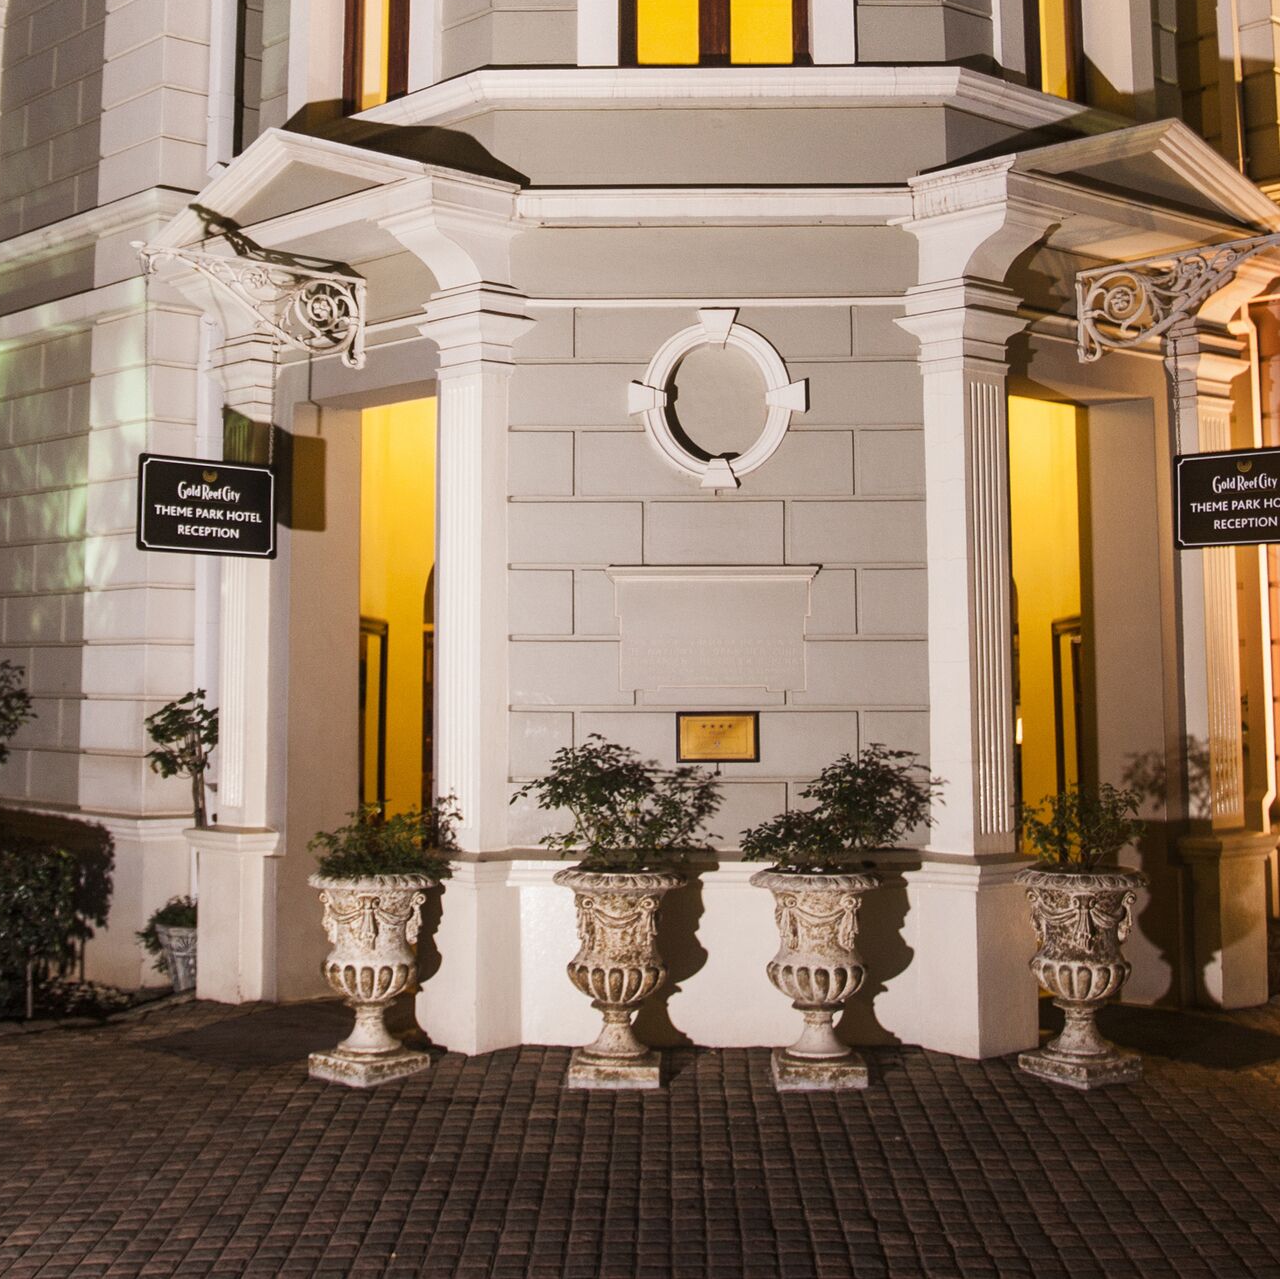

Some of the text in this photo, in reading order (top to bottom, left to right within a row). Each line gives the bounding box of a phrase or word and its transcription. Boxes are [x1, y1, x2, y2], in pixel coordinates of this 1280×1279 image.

[178, 481, 240, 503] Gold Reef City
[1212, 473, 1277, 494] Gold Reef City
[154, 504, 262, 523] THEME PARK HOTEL
[1190, 500, 1228, 513] THEME
[1231, 499, 1260, 511] PARK
[178, 524, 239, 539] RECEPTION
[1213, 516, 1278, 530] RECEPTION
